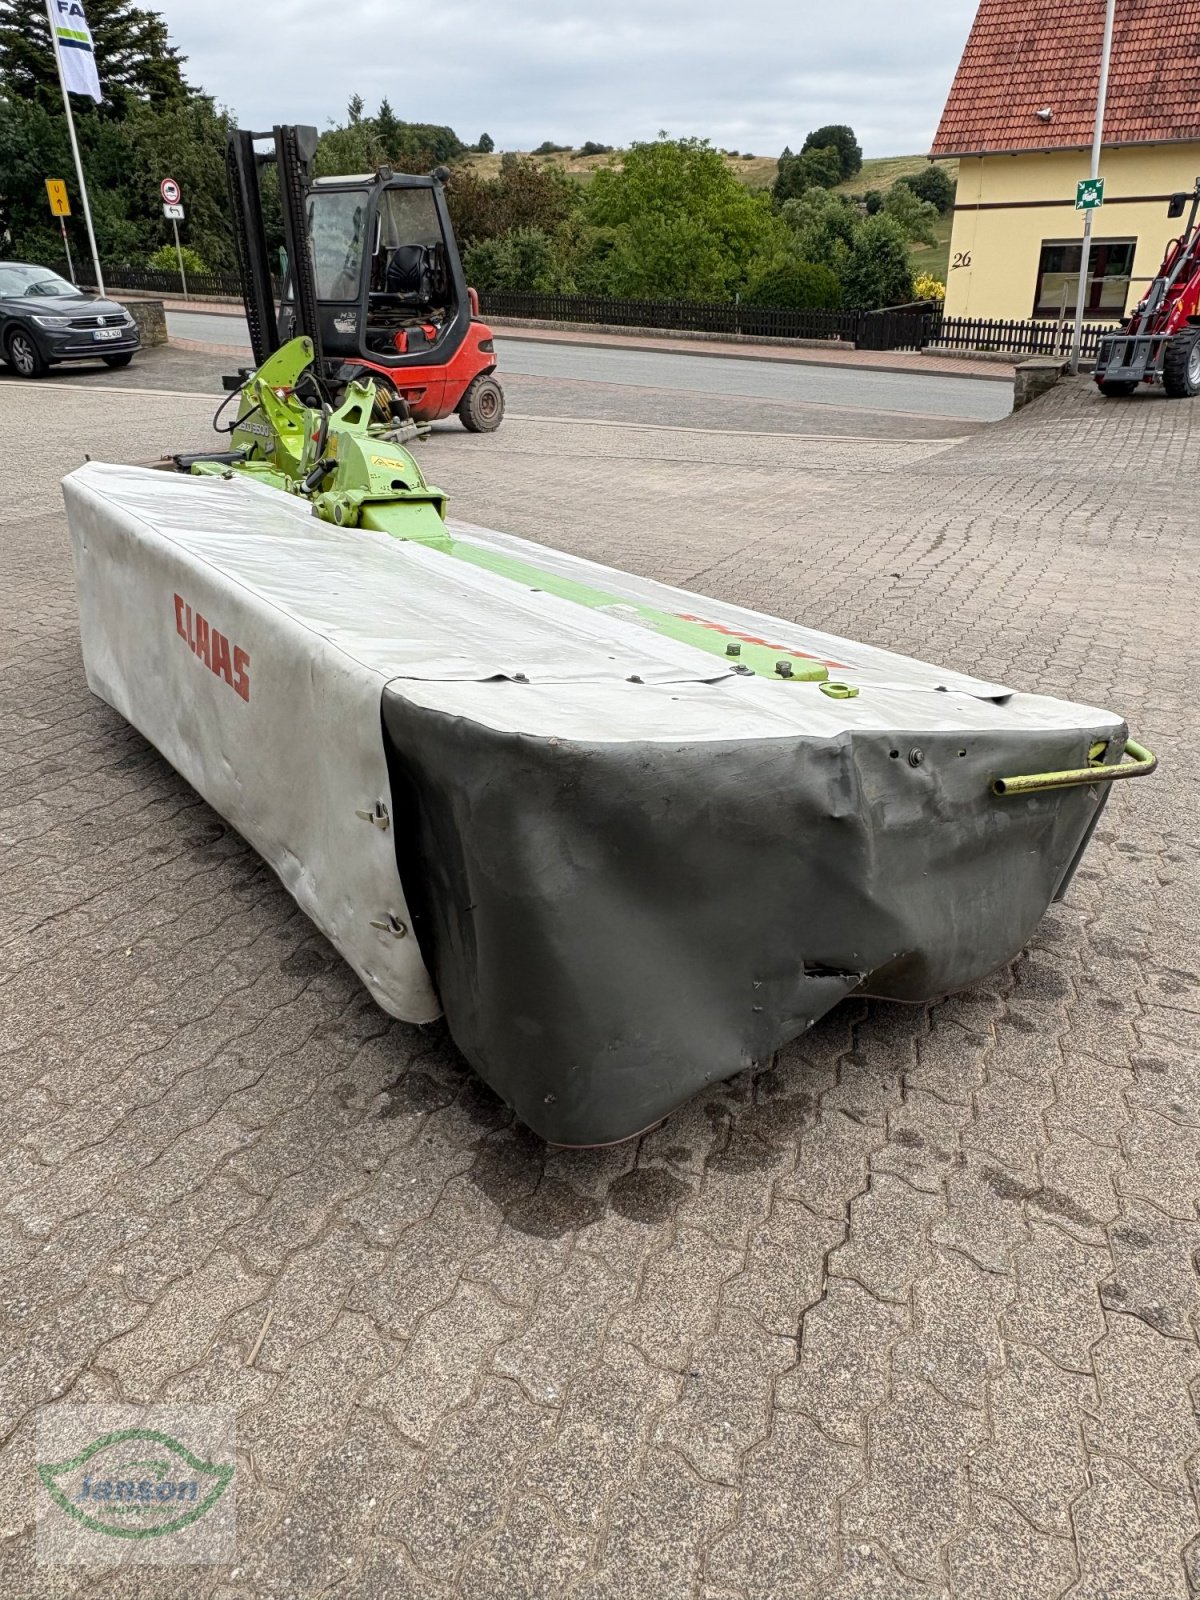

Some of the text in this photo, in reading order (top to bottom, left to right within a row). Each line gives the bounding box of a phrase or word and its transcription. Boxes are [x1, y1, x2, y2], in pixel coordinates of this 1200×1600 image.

[54, 184, 60, 194] U
[949, 250, 972, 272] 26
[174, 592, 251, 703] CLAAS
